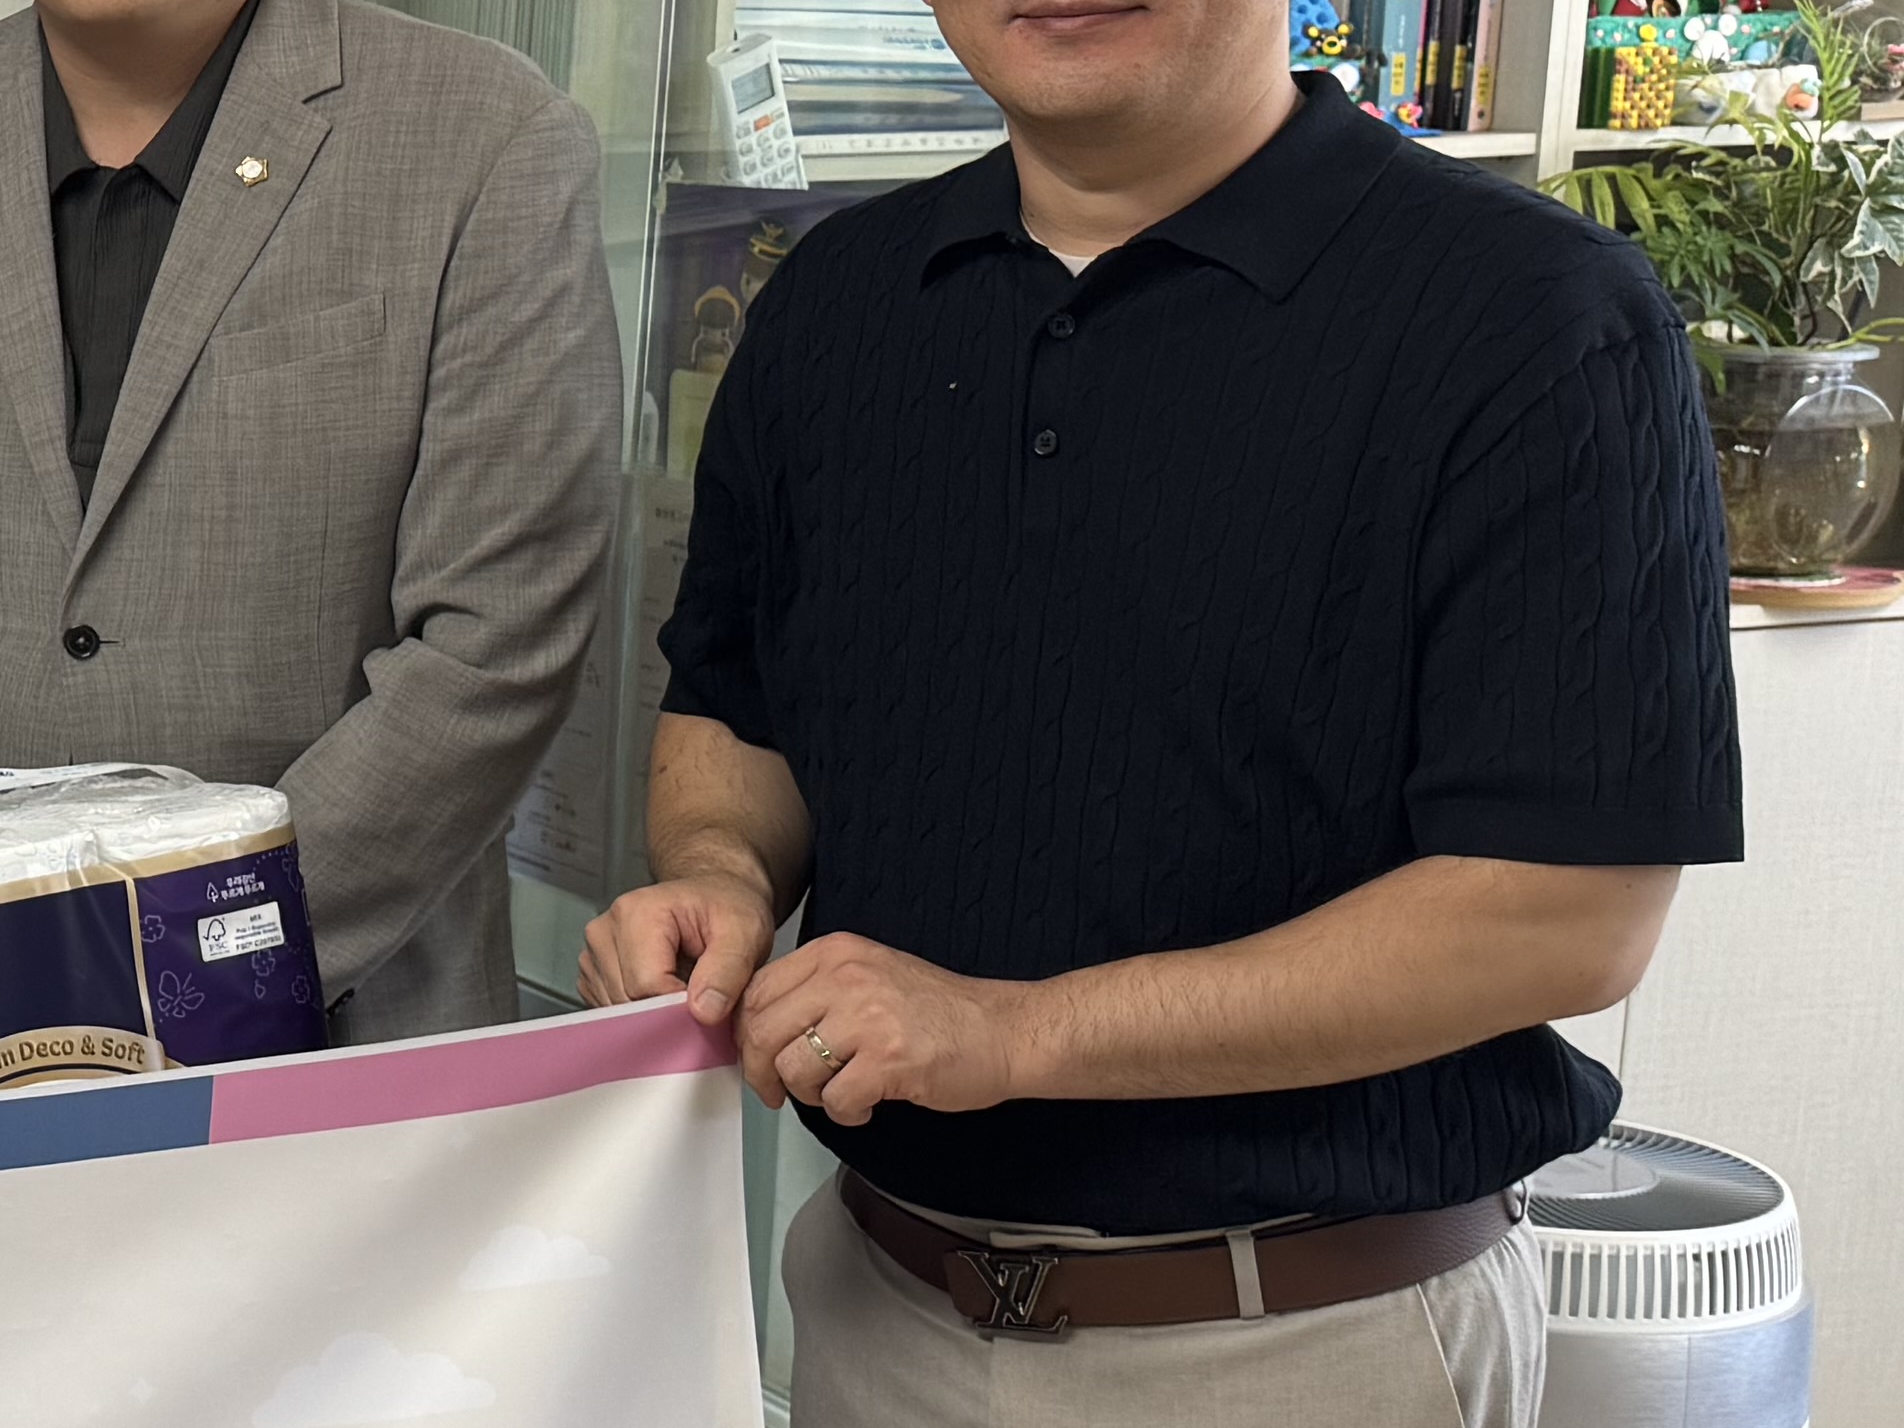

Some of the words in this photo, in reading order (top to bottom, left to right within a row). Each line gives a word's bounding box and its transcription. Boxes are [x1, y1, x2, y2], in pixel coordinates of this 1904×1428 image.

[208, 941, 228, 952] FSC
[19, 1037, 75, 1062] Deco
[80, 1037, 96, 1057] &
[101, 1037, 147, 1066] Soft
